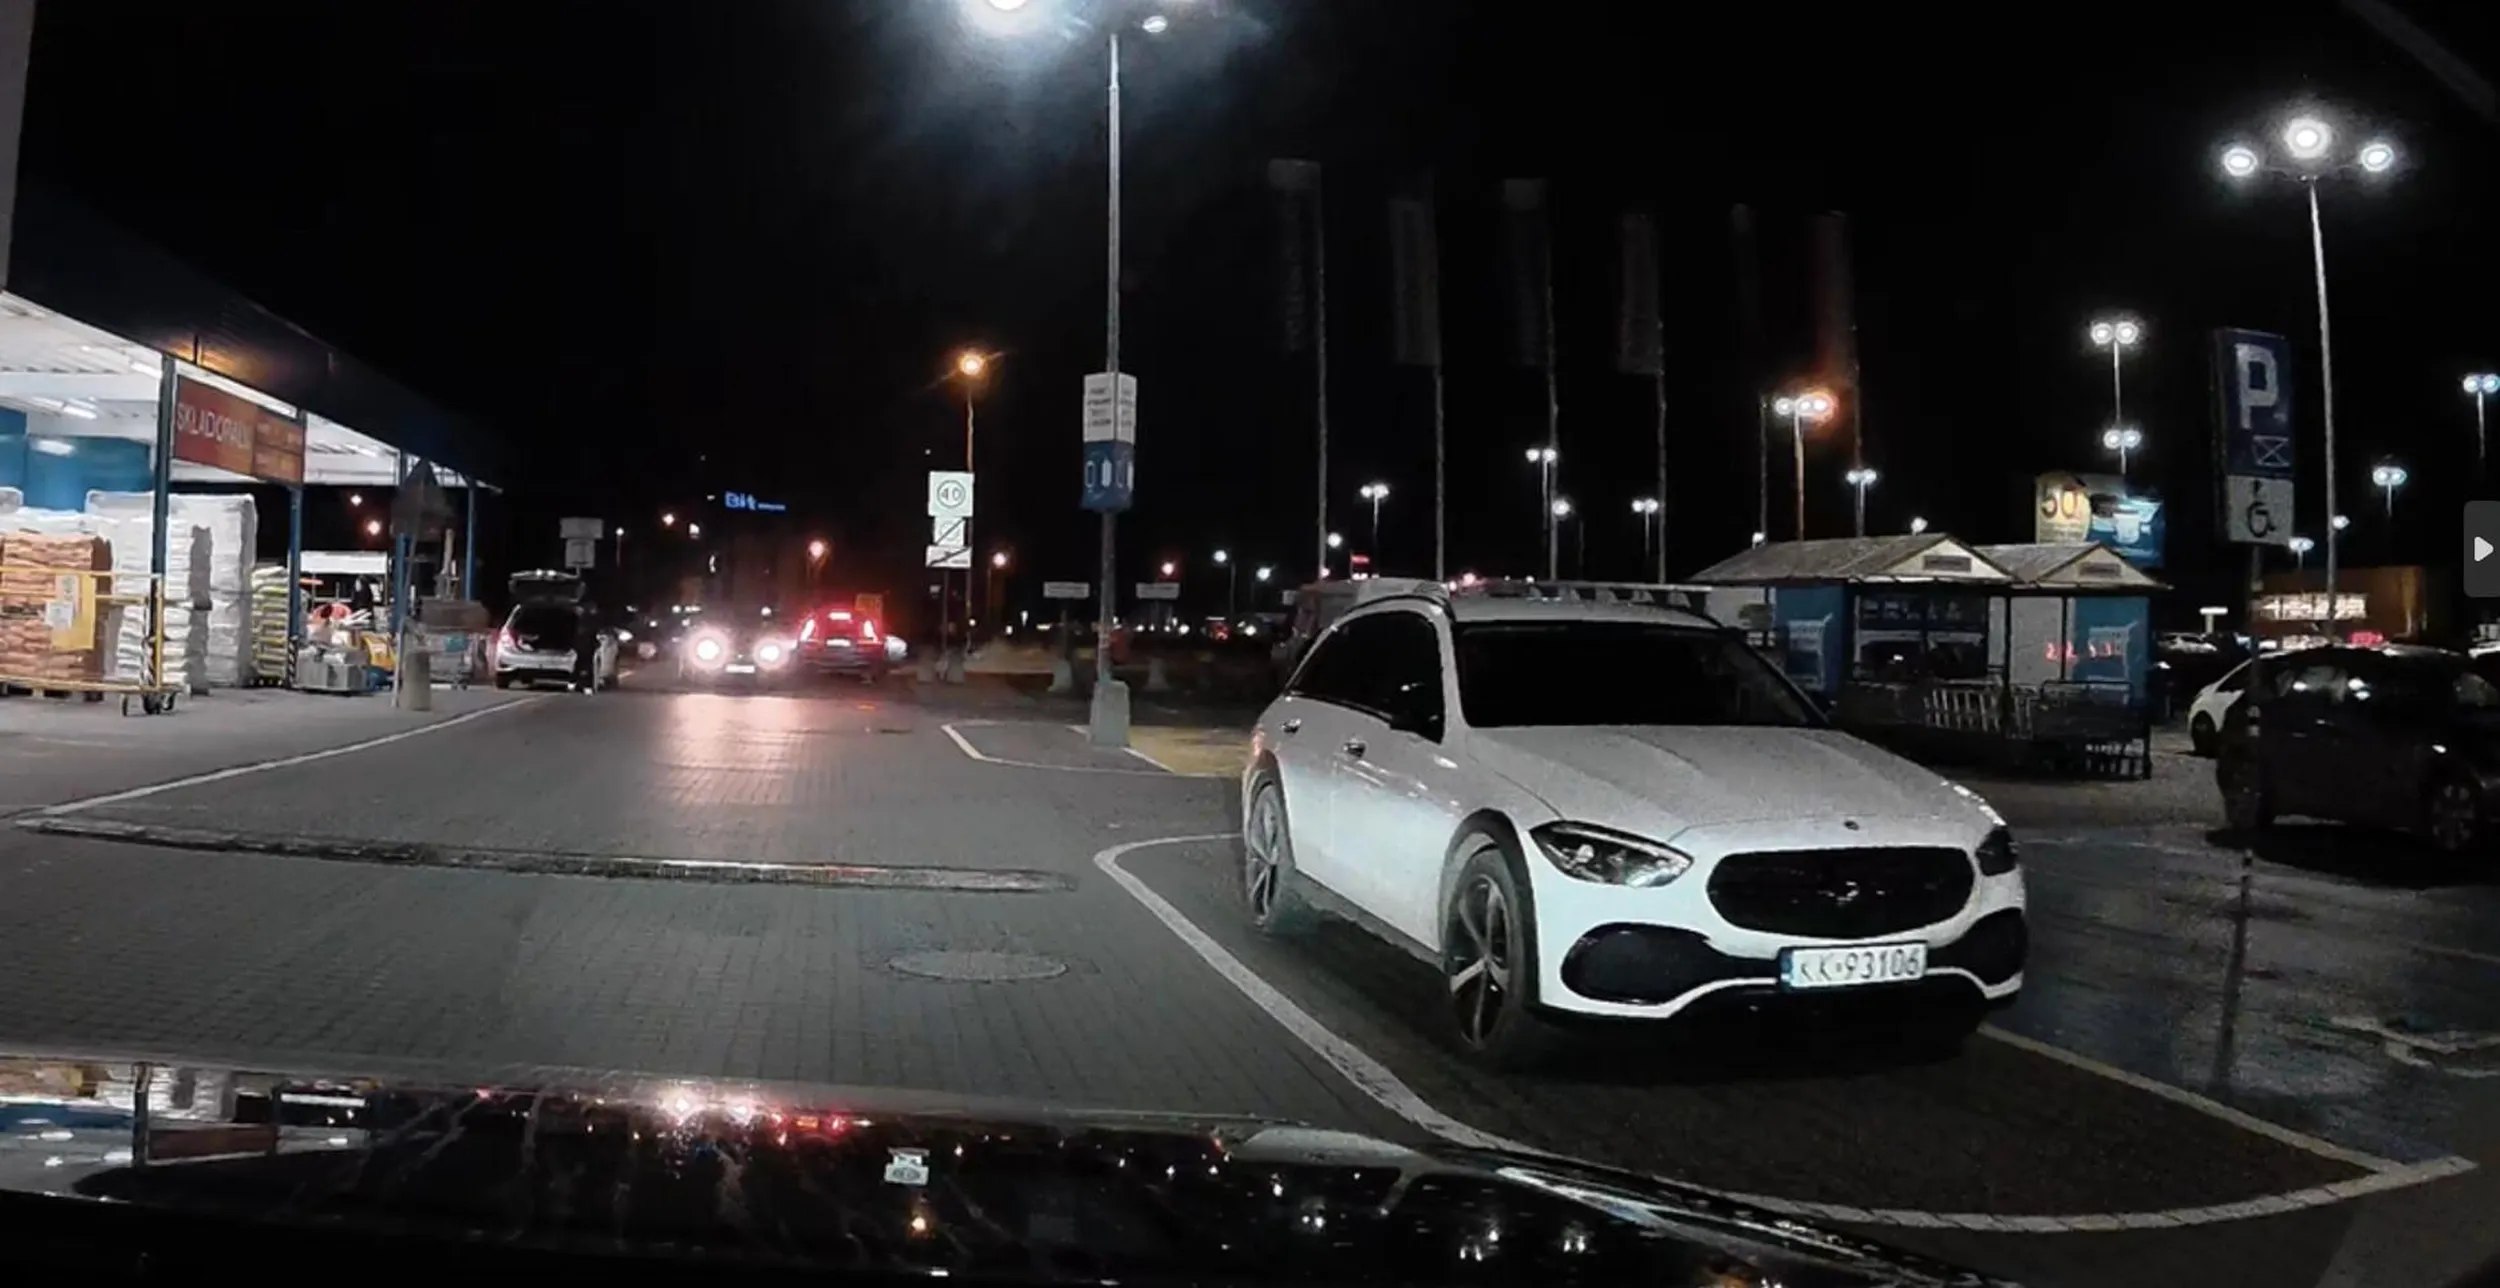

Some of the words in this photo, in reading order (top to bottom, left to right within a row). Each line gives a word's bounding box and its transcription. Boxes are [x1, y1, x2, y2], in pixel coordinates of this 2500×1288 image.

[2234, 343, 2280, 430] P
[941, 486, 963, 501] 40
[1844, 947, 1921, 981] 93106
